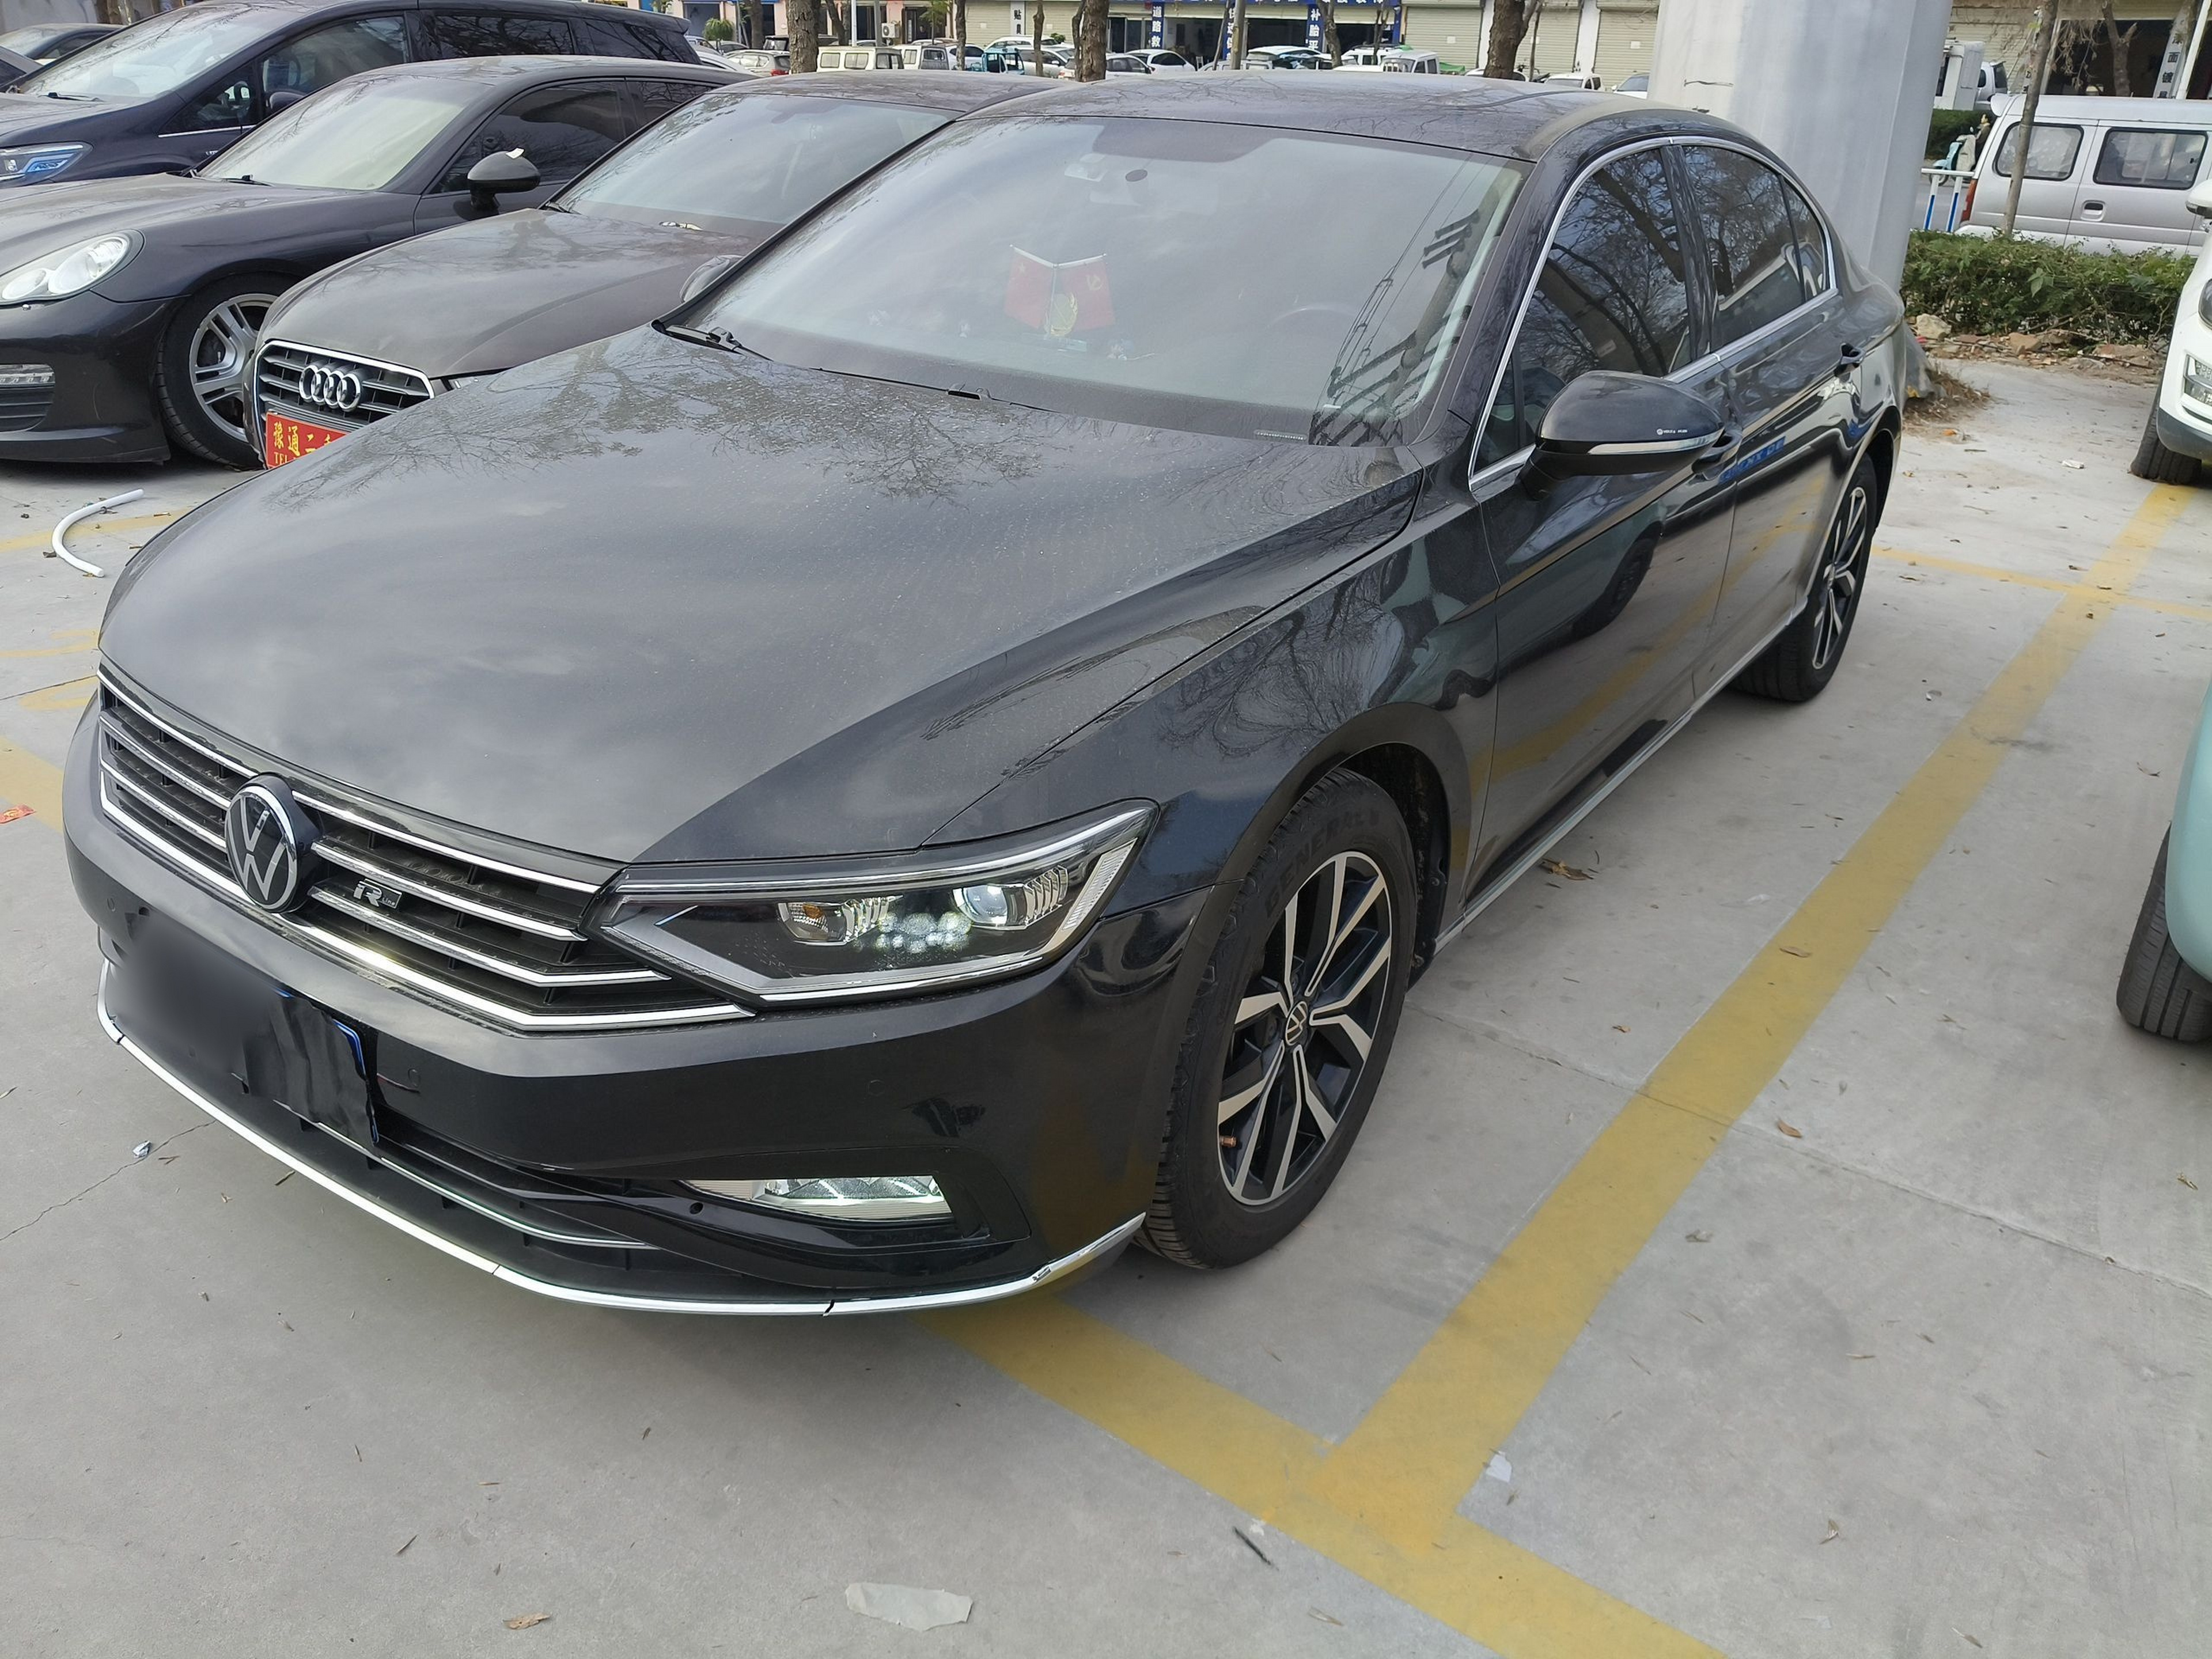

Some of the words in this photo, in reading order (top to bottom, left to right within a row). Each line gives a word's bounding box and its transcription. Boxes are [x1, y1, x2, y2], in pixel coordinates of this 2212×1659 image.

[1151, 6, 1162, 47] 道路救
[353, 881, 382, 907] R
